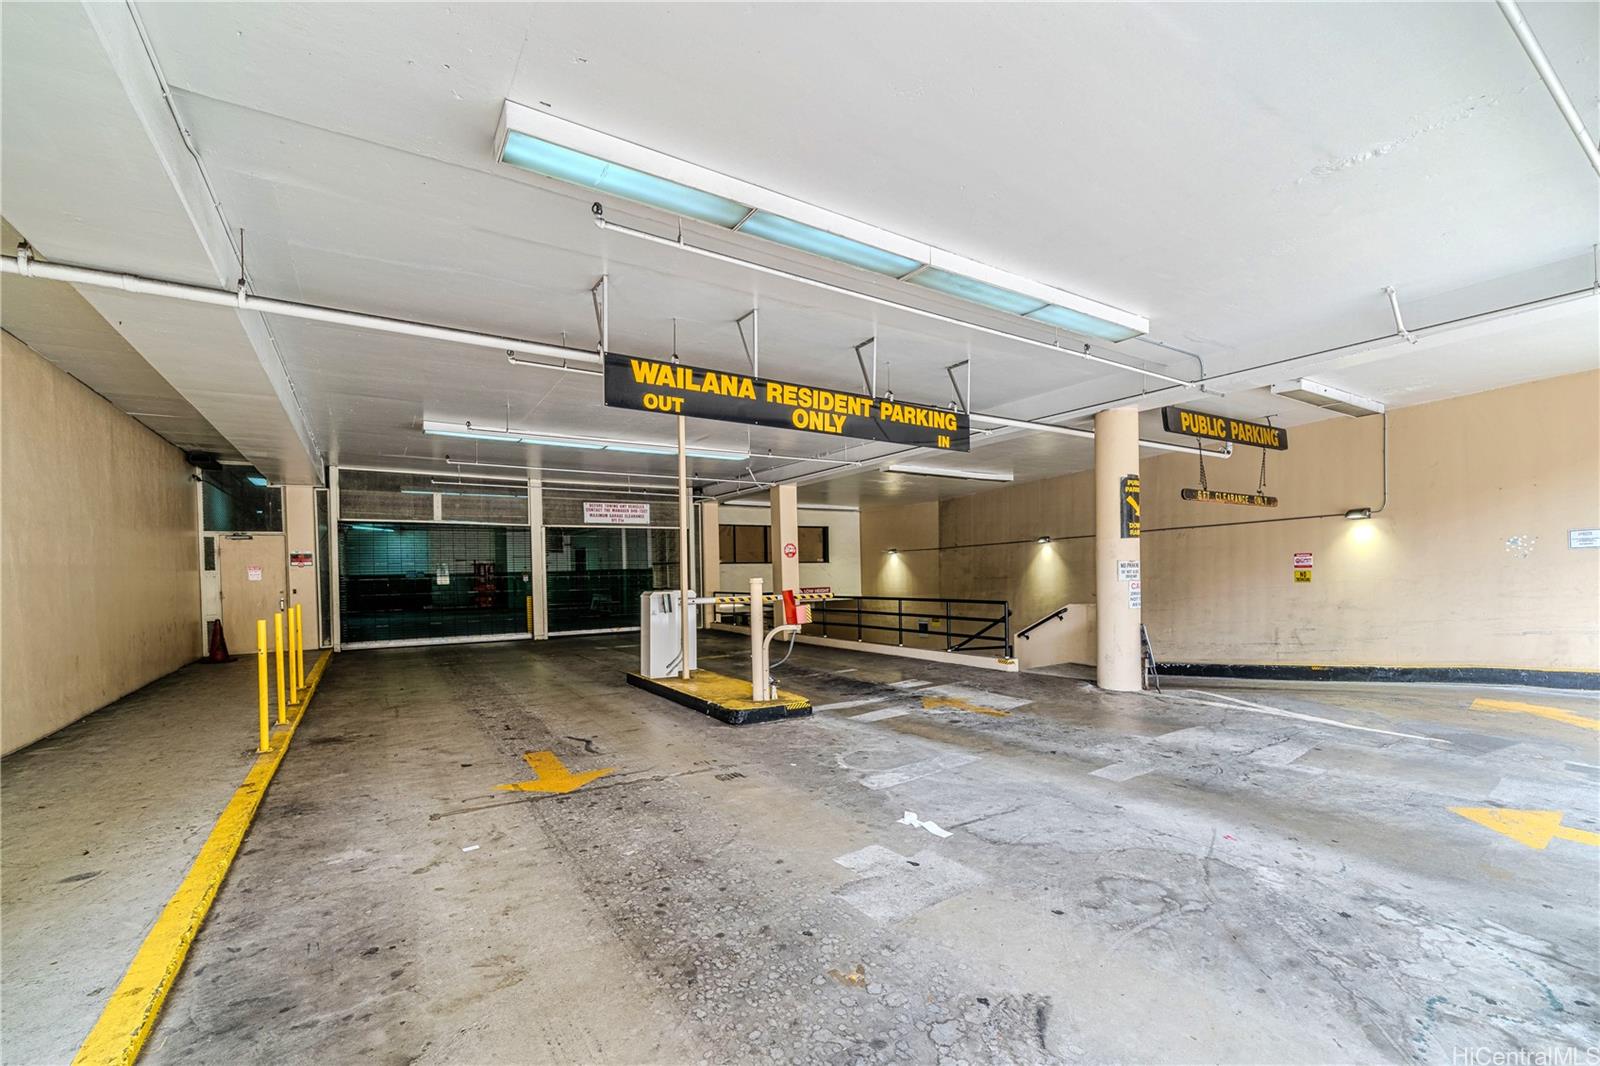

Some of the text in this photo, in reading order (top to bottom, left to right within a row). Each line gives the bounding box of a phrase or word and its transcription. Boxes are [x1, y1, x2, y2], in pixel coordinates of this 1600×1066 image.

[630, 359, 957, 430] WAILANA RESIDENT PARKING
[642, 393, 685, 413] OUT
[792, 408, 846, 433] ONLY
[1181, 411, 1279, 446] PUBLIC PARKING
[937, 435, 950, 448] IN
[1215, 492, 1249, 504] CLEARANCE
